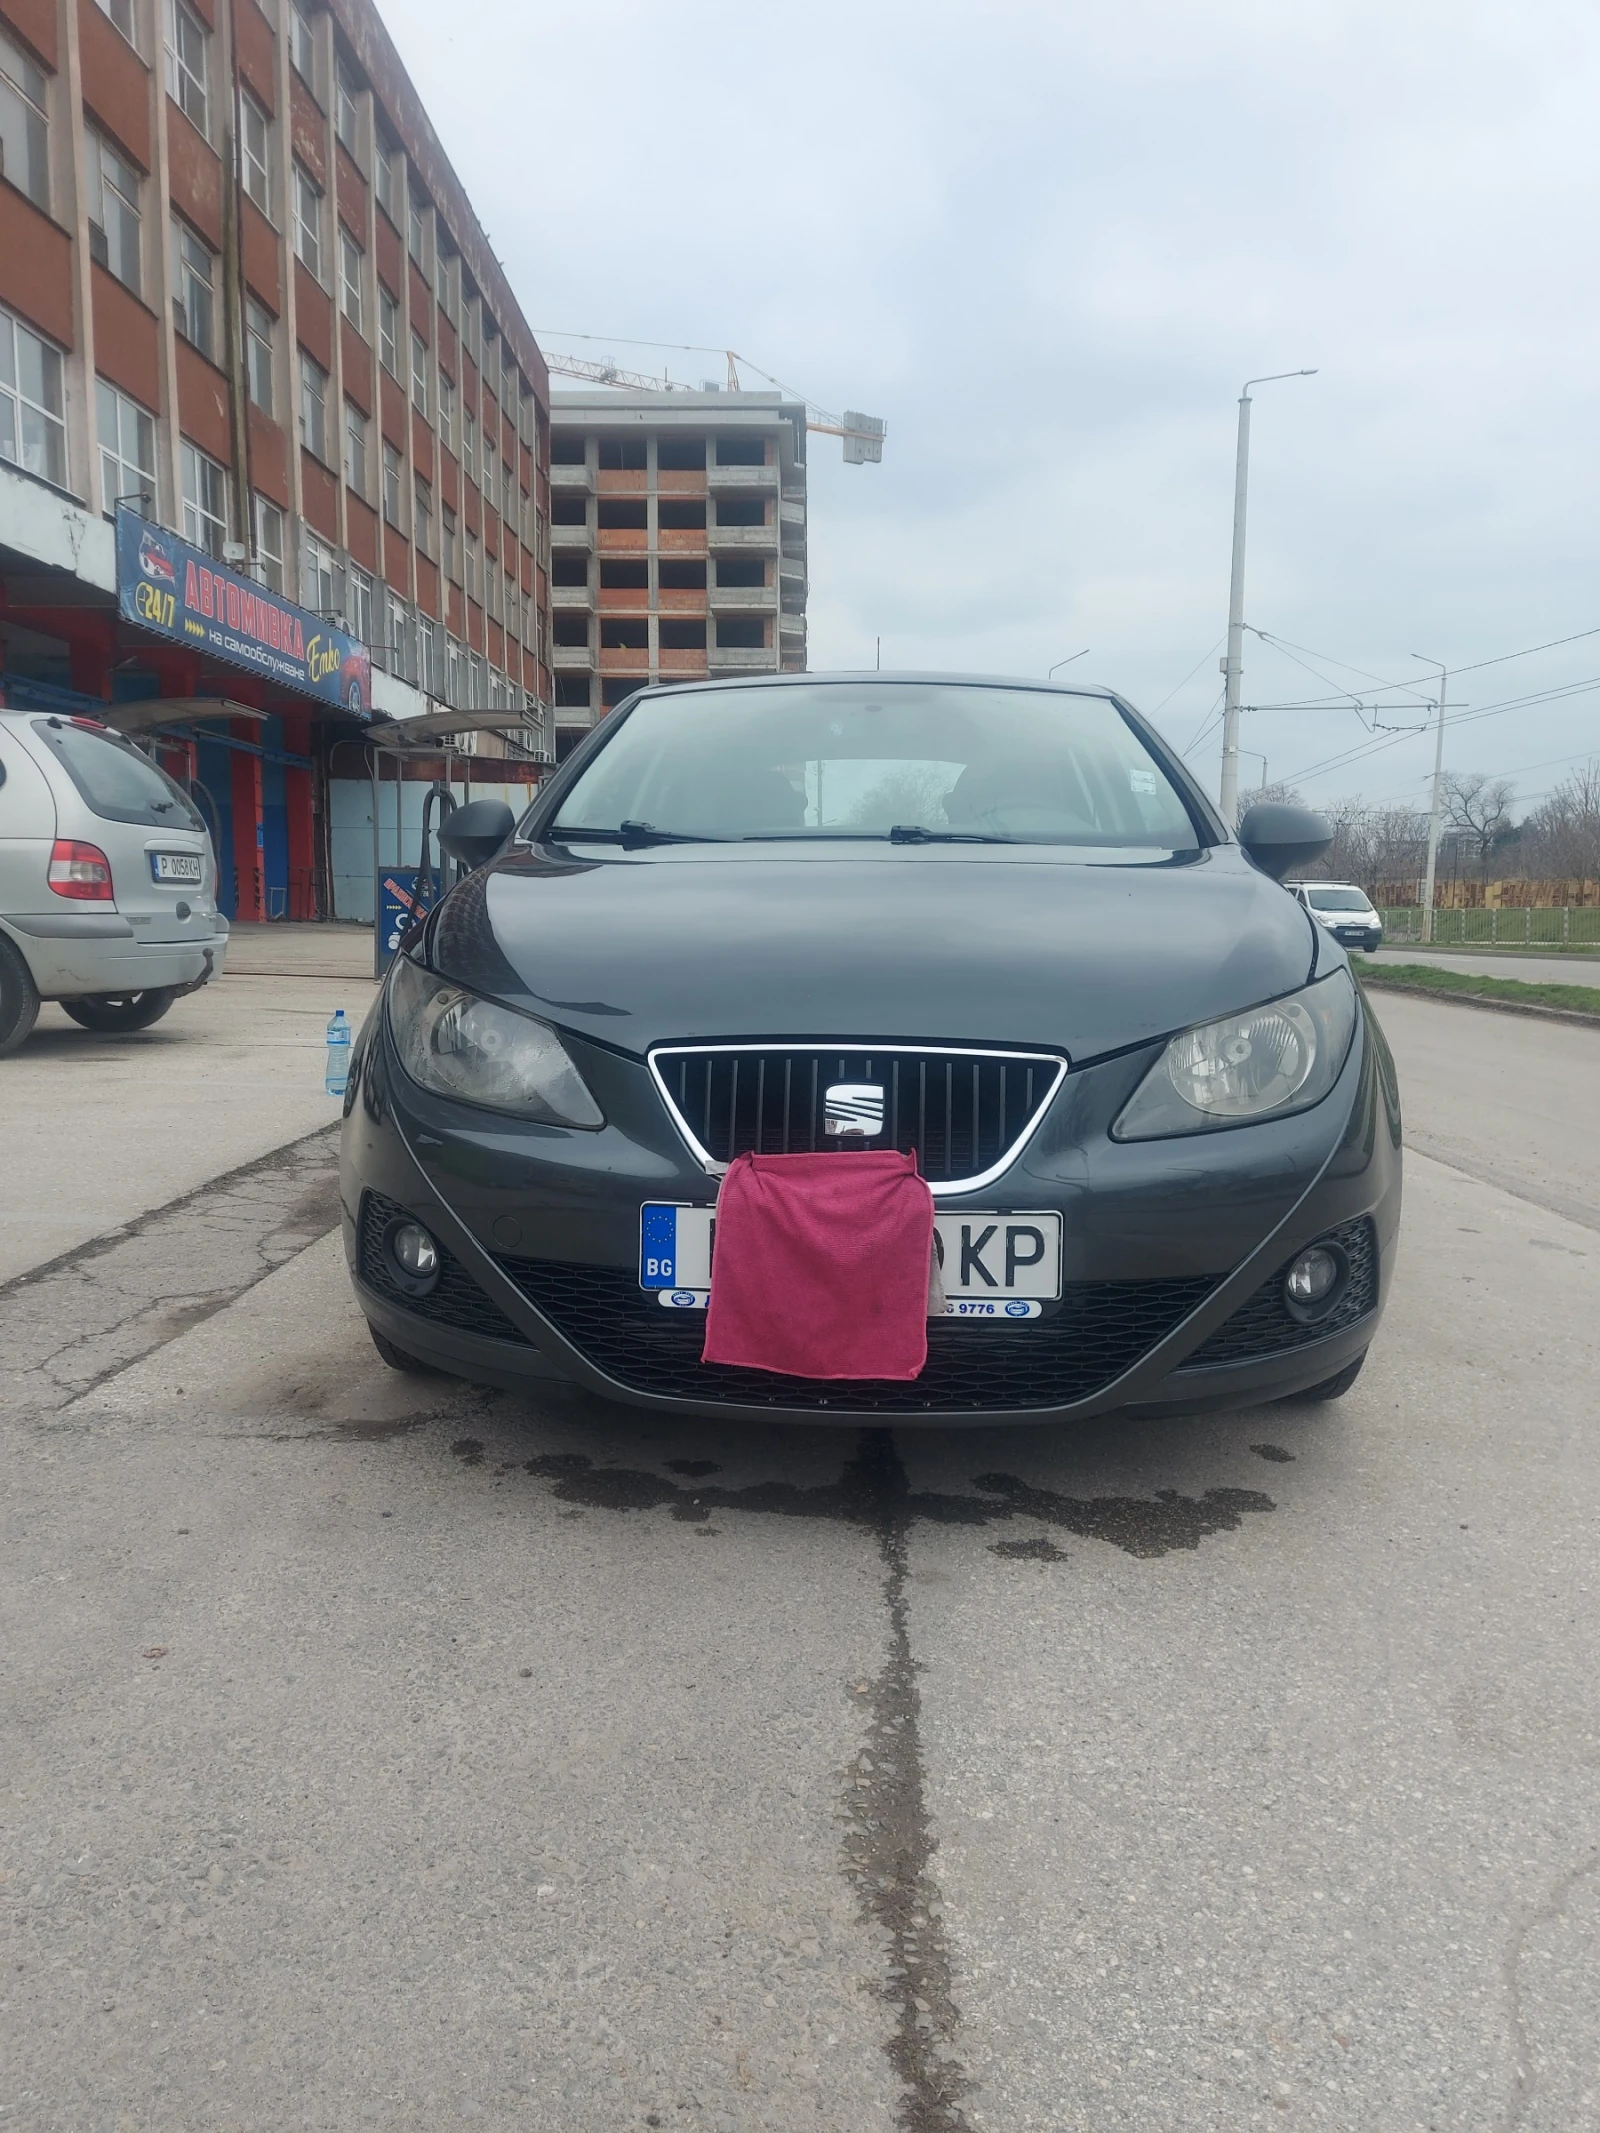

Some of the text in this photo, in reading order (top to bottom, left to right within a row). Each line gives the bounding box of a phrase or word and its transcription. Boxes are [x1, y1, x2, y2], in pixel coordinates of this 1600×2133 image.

[144, 586, 175, 628] 24/7
[185, 559, 305, 662] АВТОМИВКА
[208, 628, 305, 681] на самообслужване
[646, 1258, 673, 1277] BG
[958, 1303, 995, 1314] 9776
